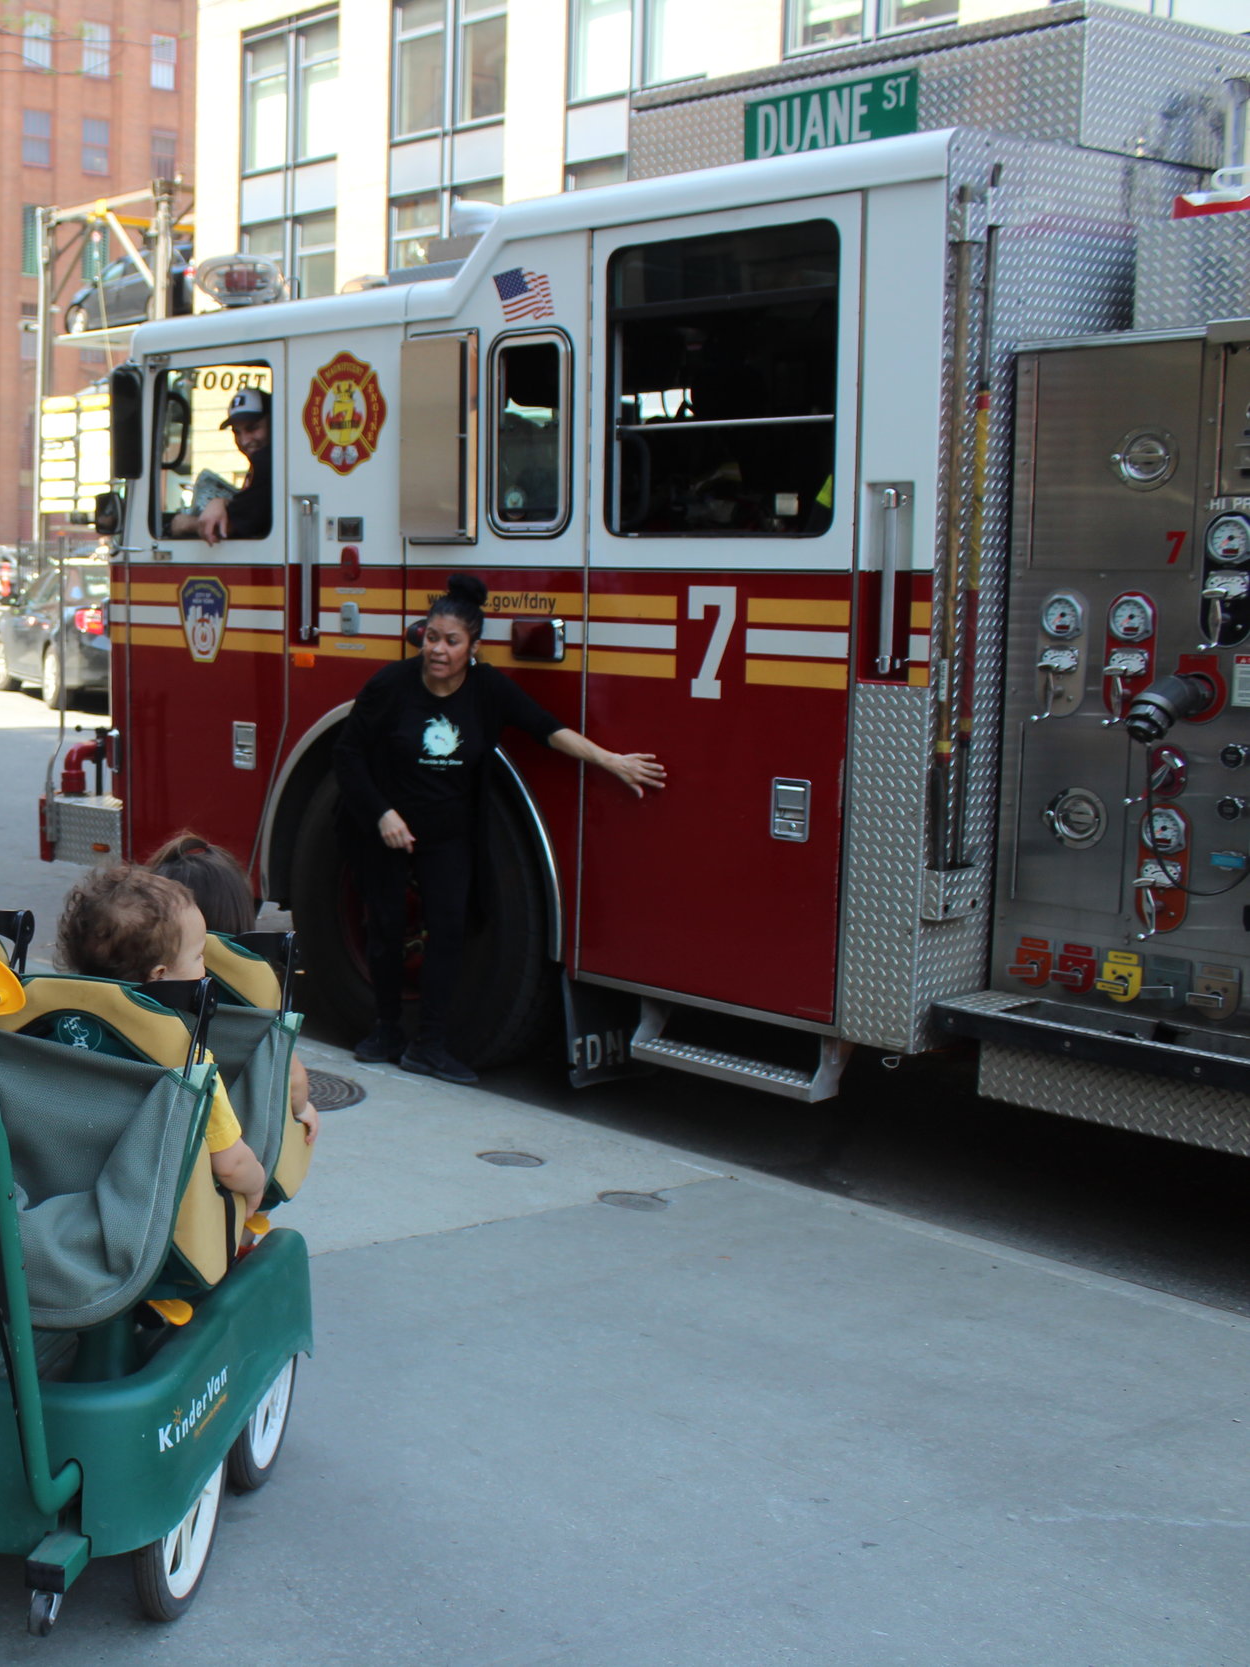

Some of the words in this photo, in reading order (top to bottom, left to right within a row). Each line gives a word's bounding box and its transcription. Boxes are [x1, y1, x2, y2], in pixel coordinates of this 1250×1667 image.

[756, 83, 873, 160] DUANE
[882, 76, 910, 111] ST
[1210, 499, 1226, 510] HI
[1166, 530, 1188, 565] 7
[688, 585, 737, 699] 7
[158, 1367, 227, 1453] KinderVan
